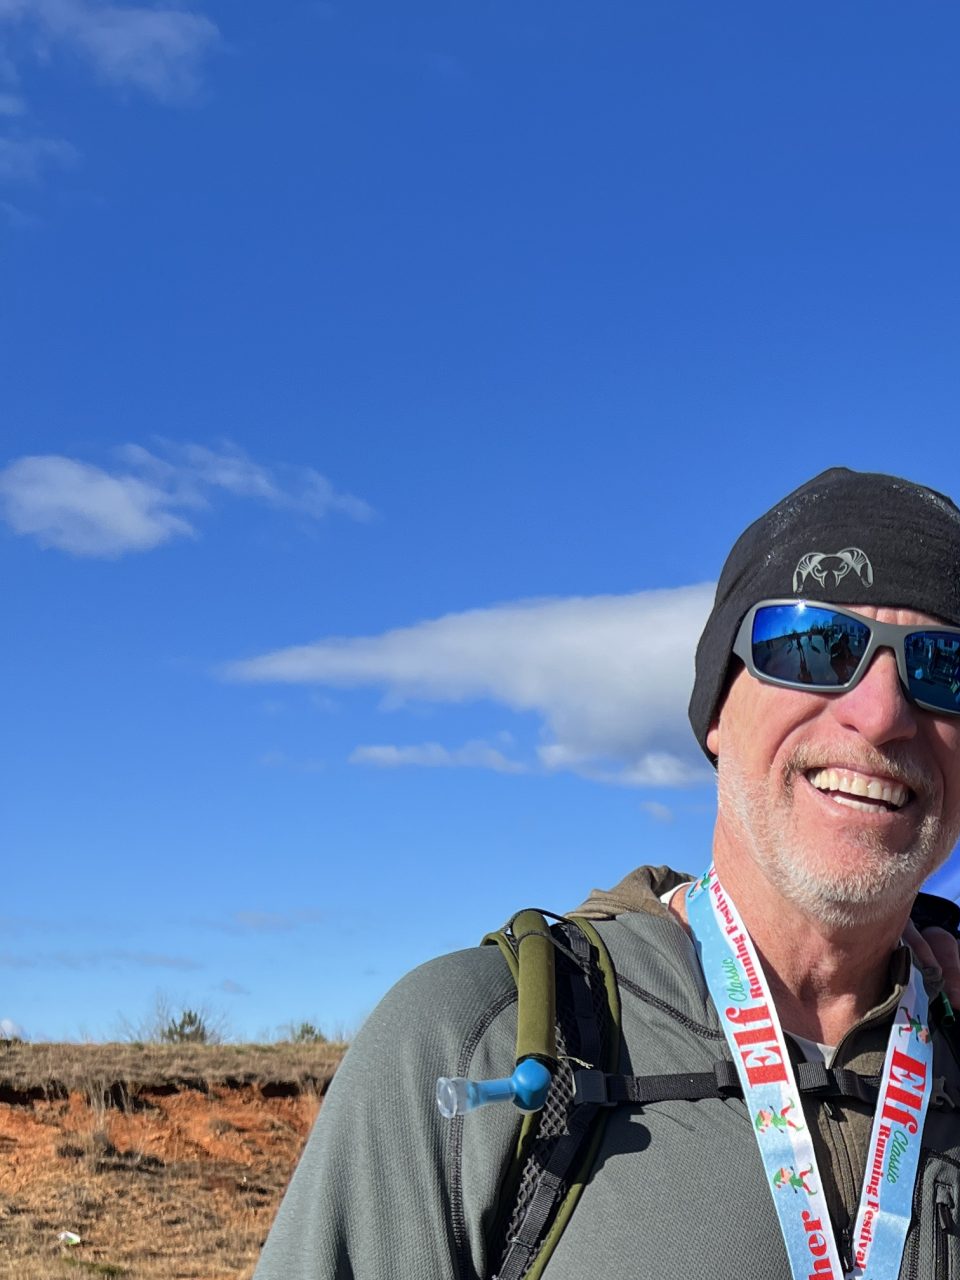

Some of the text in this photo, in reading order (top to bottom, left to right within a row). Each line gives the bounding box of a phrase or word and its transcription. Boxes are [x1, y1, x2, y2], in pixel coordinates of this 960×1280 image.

[710, 881, 765, 999] Running Festival
[721, 958, 748, 1002] Classic
[725, 1003, 790, 1089] Elf
[881, 1046, 928, 1135] Elf
[855, 1123, 892, 1271] Running Festival
[887, 1129, 909, 1184] Classic
